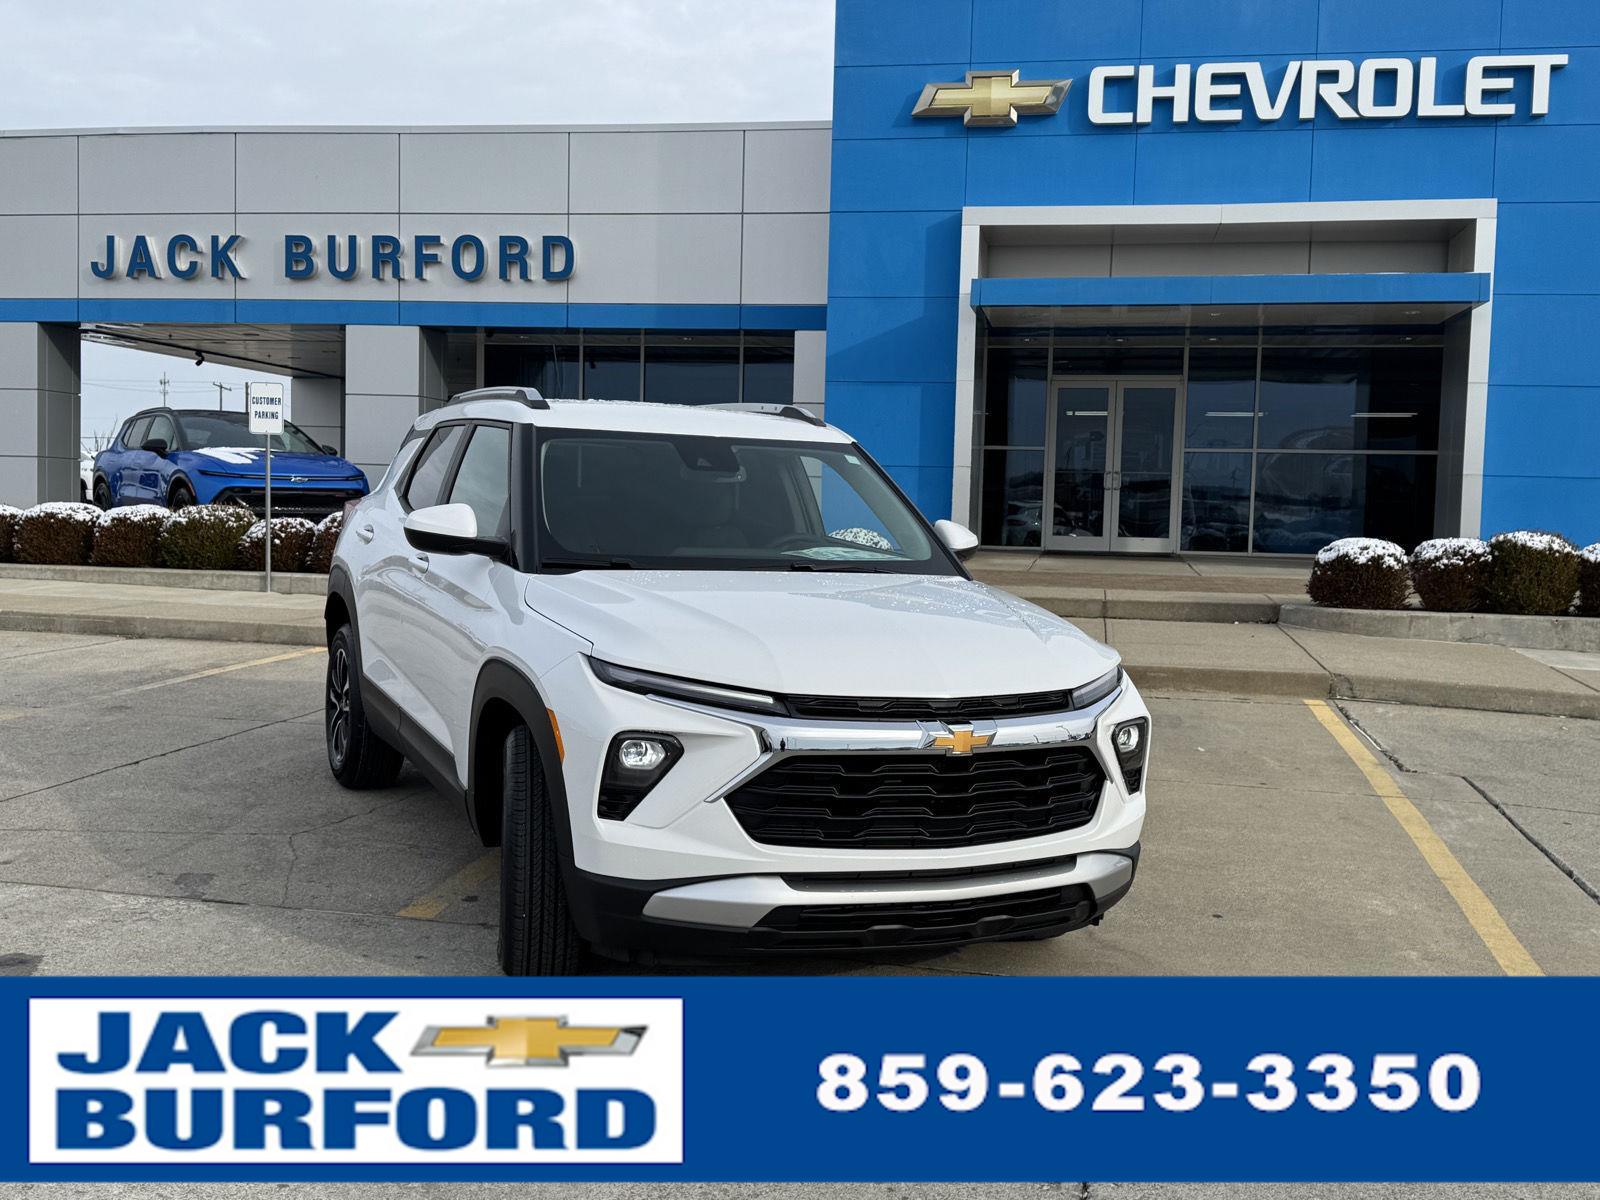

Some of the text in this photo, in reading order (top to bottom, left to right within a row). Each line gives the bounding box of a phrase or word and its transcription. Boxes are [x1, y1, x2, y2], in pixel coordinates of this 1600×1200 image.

[1087, 53, 1569, 126] CHEVROLET
[91, 234, 576, 281] JACK BURFORD
[252, 397, 281, 405] CUSTOMER
[255, 411, 278, 419] PARKING
